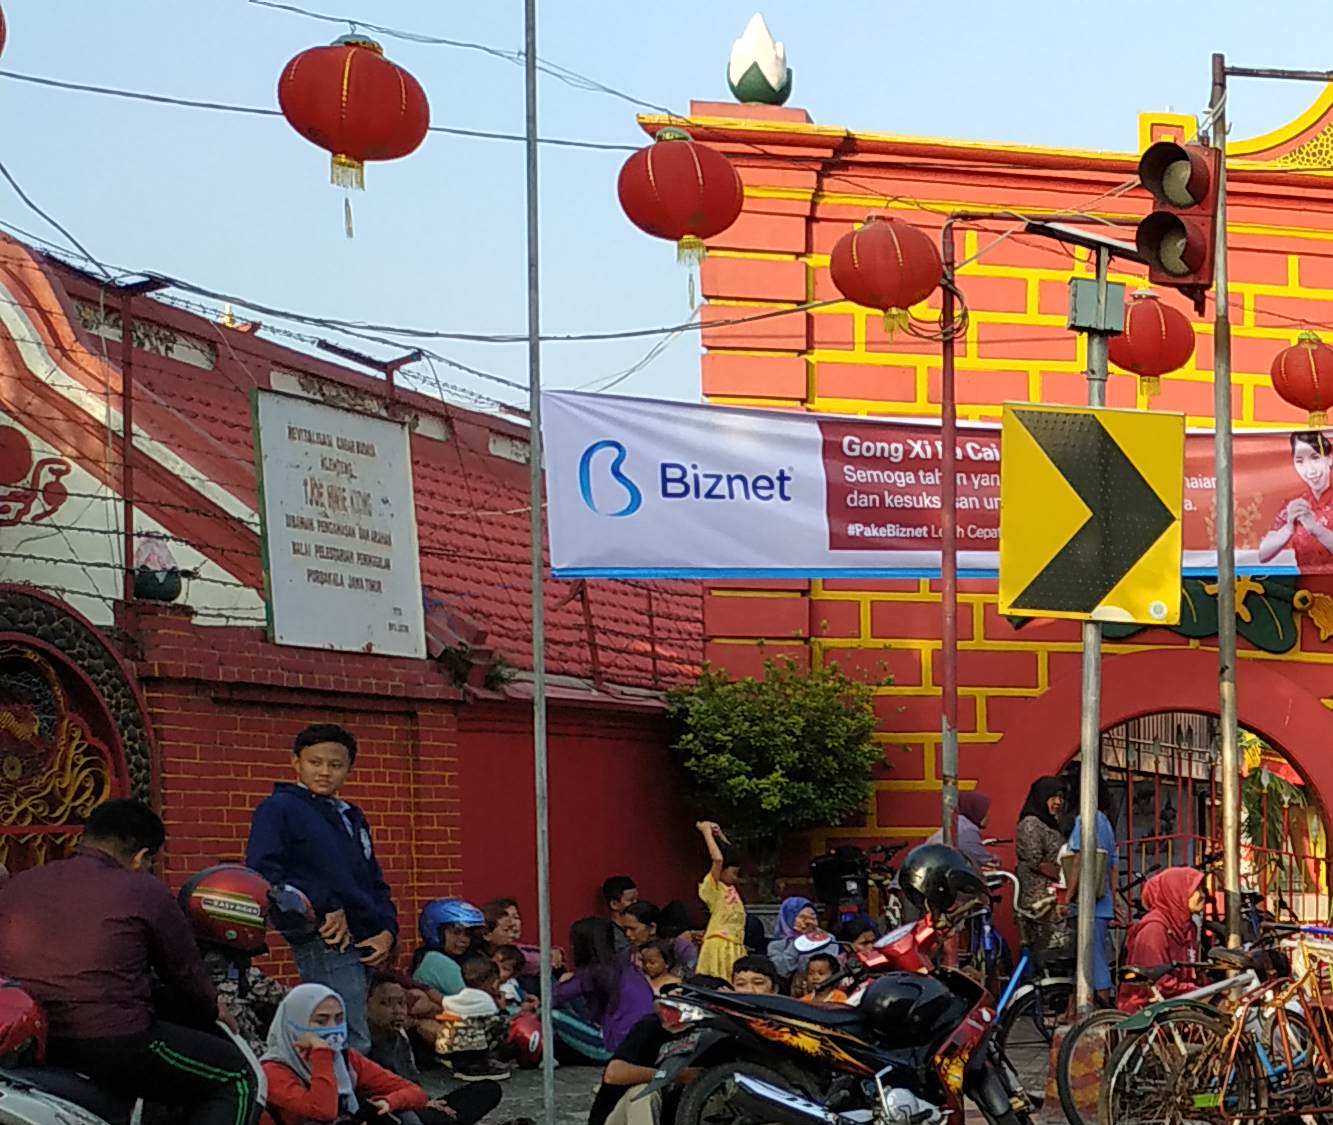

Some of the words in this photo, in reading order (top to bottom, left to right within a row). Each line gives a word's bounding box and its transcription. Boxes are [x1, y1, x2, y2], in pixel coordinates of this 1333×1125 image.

[842, 434, 903, 463] Gong
[907, 439, 932, 459] Xi
[660, 462, 793, 502] Biznet
[843, 465, 915, 487] Semoga
[971, 473, 1000, 490] yan
[846, 490, 880, 507] dan
[847, 523, 928, 538] #PakeBiznet
